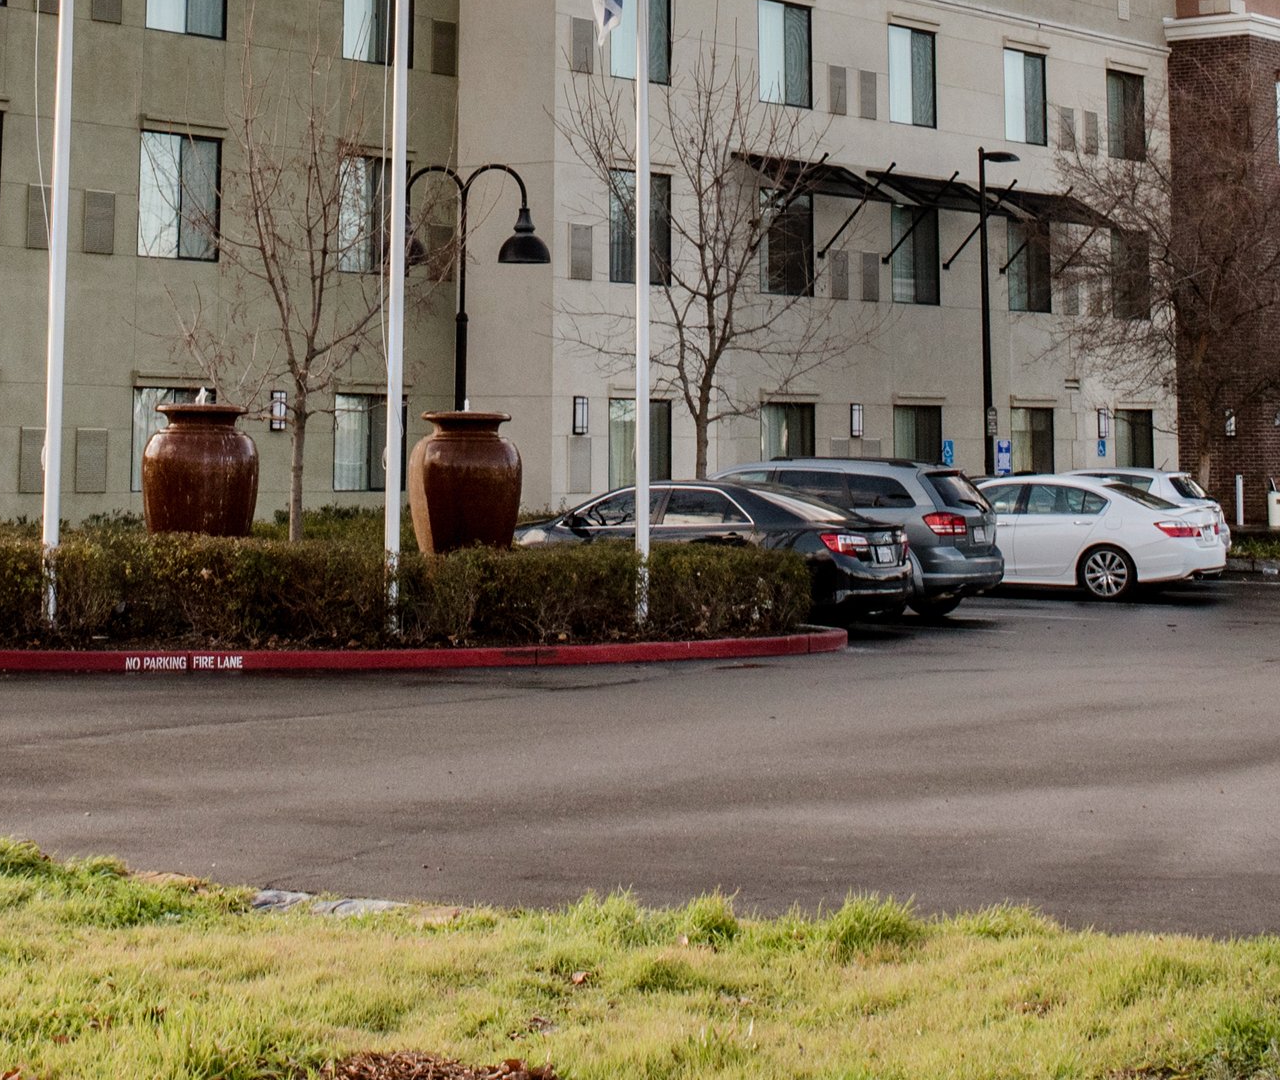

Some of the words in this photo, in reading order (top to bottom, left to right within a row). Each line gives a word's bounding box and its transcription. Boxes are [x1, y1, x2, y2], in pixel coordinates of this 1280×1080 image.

[125, 657, 141, 670] NO
[143, 656, 187, 669] PARKING
[193, 656, 215, 669] FIRE
[217, 656, 243, 669] LANE
